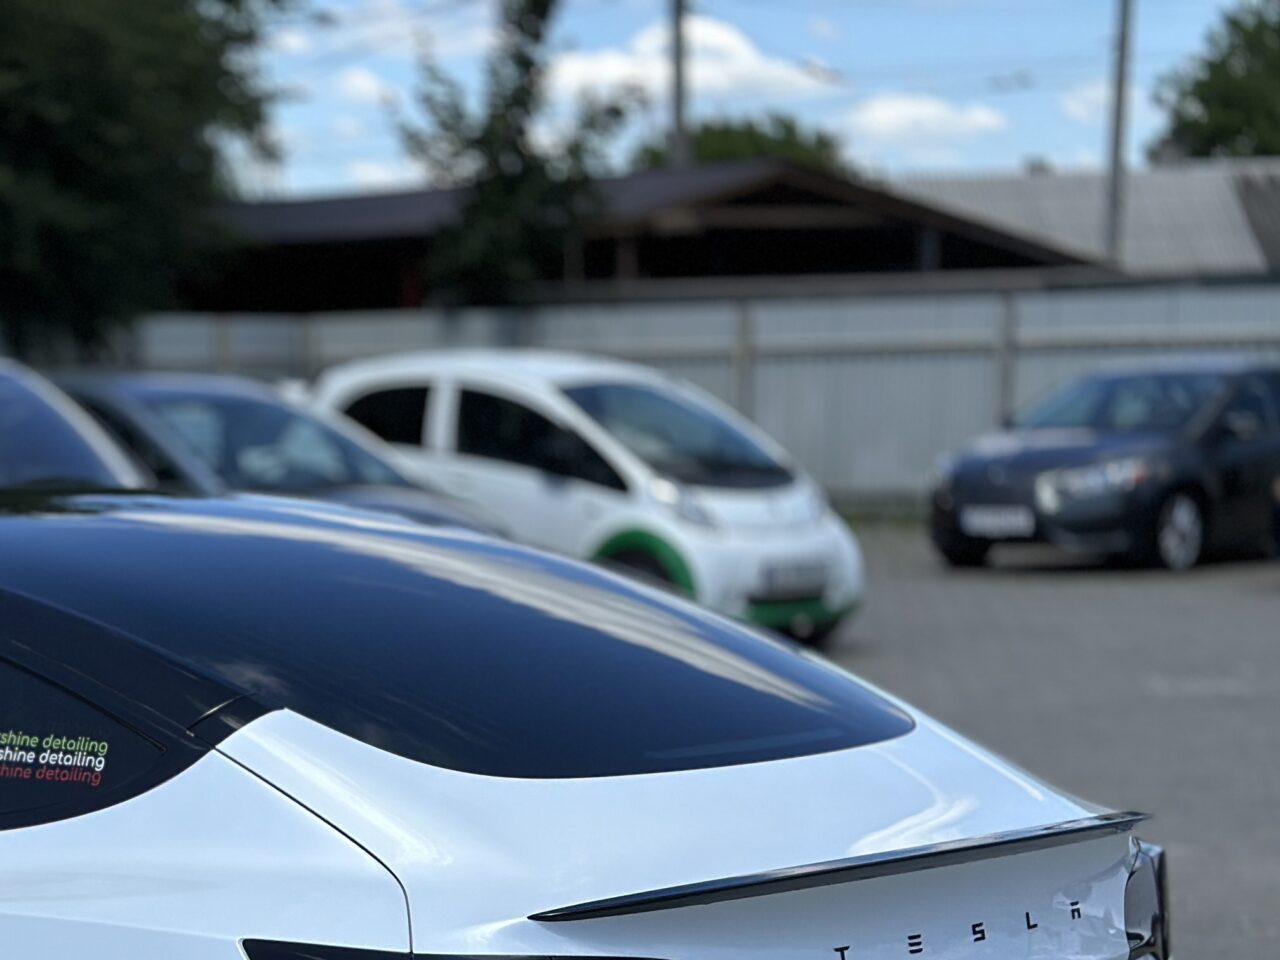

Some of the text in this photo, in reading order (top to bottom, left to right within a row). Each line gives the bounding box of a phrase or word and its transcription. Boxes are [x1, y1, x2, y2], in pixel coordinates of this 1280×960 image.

[42, 734, 108, 756] detailing
[38, 751, 105, 771] detailing
[35, 765, 102, 786] detailing
